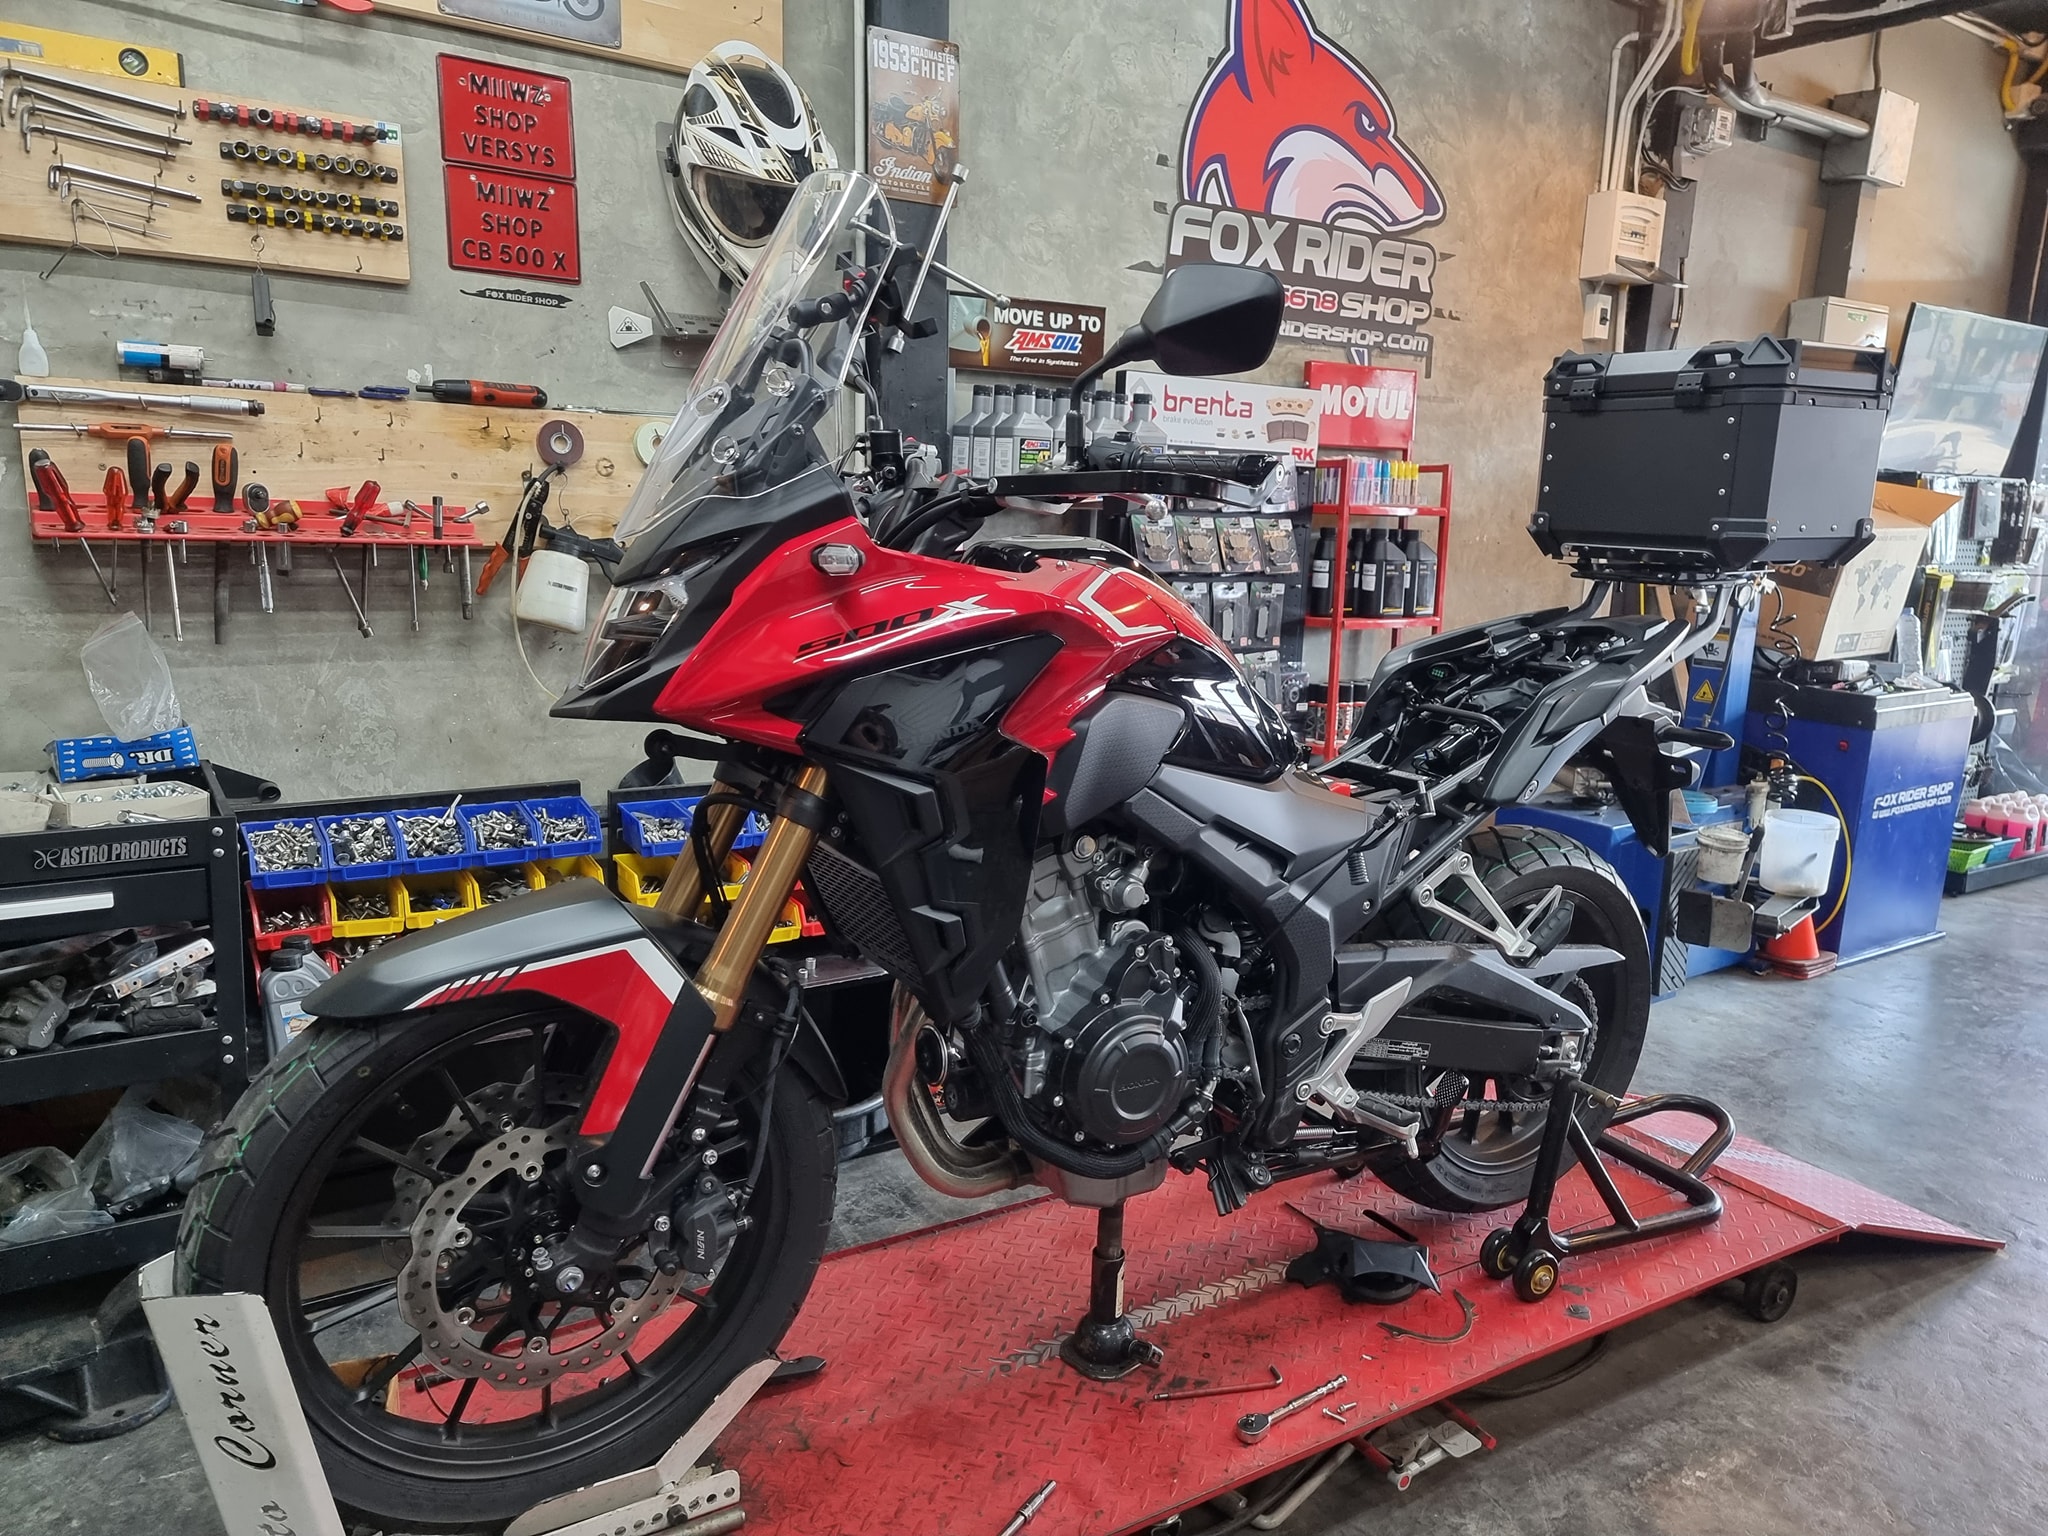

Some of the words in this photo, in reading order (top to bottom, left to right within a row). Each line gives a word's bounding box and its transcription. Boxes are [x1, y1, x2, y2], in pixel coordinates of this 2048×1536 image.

[873, 39, 910, 73] 1953
[911, 45, 955, 64] ROADMASTER
[911, 56, 955, 82] CHIEF
[468, 72, 545, 107] MIIWZ
[474, 105, 538, 134] SHOP
[461, 132, 556, 168] VERSYS
[873, 157, 932, 183] Indian
[476, 181, 550, 212] MIIWZ
[876, 179, 930, 191] MOTORCYCLE
[481, 212, 543, 239] SHOP
[462, 239, 492, 261] CB
[499, 243, 545, 268] 500
[553, 251, 566, 272] X
[1169, 205, 1289, 272] FOX
[1292, 224, 1436, 293] RIDER
[485, 290, 504, 299] FOX
[506, 293, 533, 303] RIDER
[535, 297, 559, 307] SHOP
[1340, 292, 1430, 326] SHOP
[994, 306, 1044, 328] MOVE
[1050, 312, 1073, 330] UP
[1078, 315, 1101, 333] TO
[1011, 331, 1080, 351] AMSOIL
[1046, 359, 1079, 367] Synthetics
[1163, 384, 1252, 418] brenta
[1320, 384, 1410, 420] MOTUL
[1162, 414, 1182, 424] brake
[1183, 416, 1214, 426] evolution
[1291, 447, 1315, 461] RK
[129, 748, 174, 766] DR.
[1873, 793, 1898, 810] FOX
[1898, 787, 1927, 804] RIDER
[1927, 781, 1954, 798] SHOP
[60, 844, 108, 867] ASTRO
[111, 837, 188, 861] PRODUCTS
[696, 1229, 705, 1260] NISSIN
[194, 1313, 277, 1470] Corner
